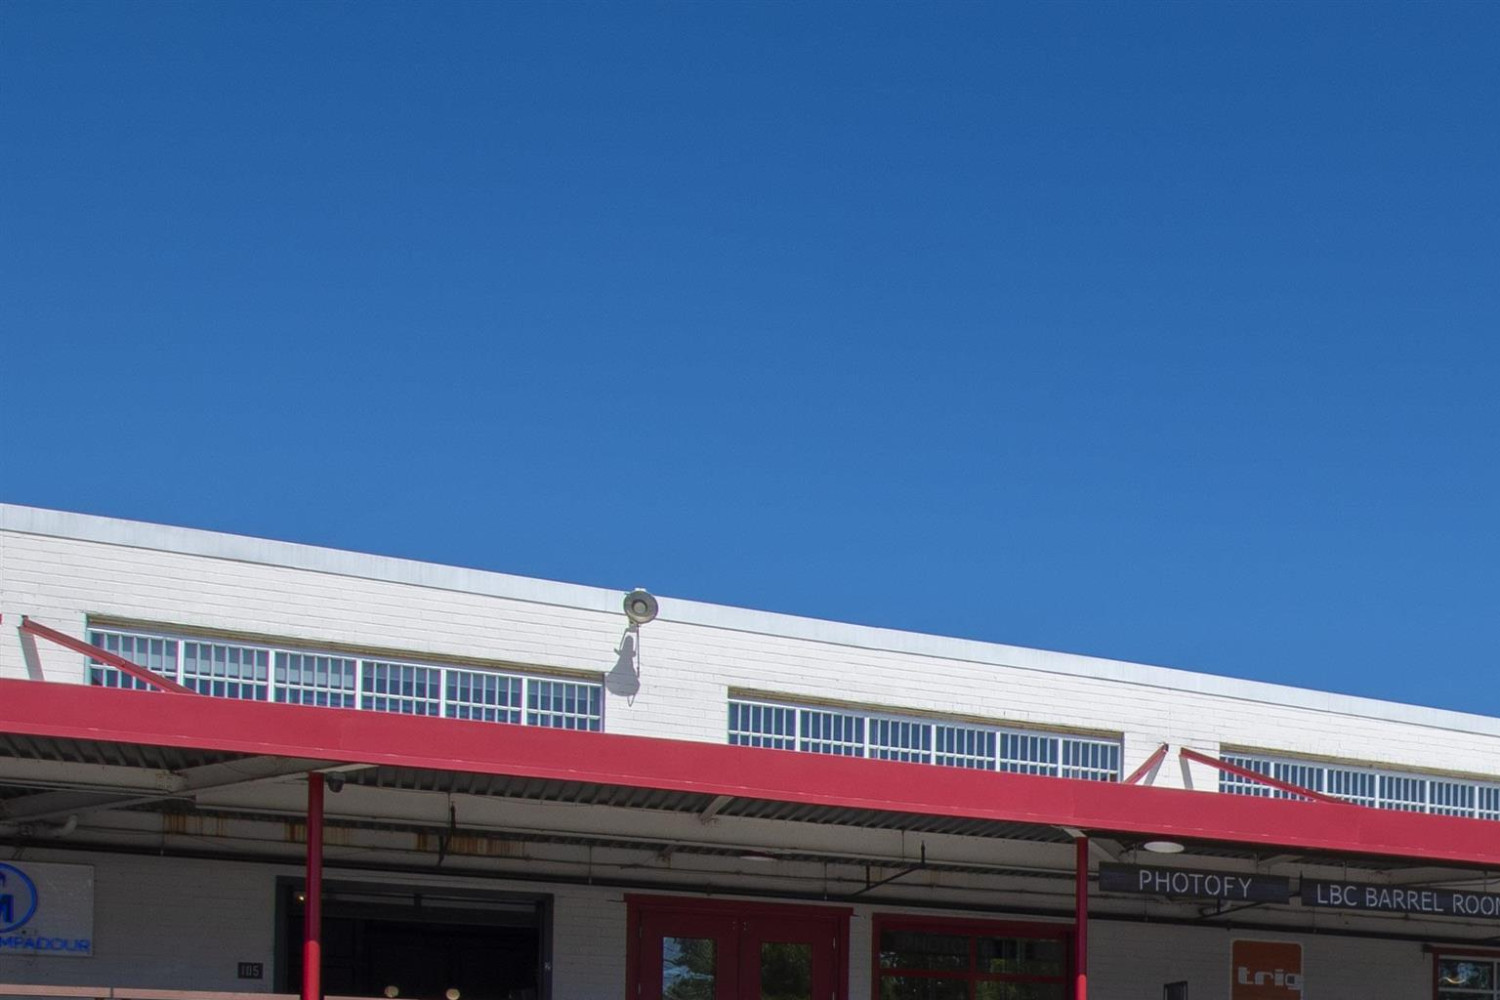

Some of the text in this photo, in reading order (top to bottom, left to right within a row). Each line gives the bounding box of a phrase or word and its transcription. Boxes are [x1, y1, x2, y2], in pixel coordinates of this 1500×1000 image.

[1138, 869, 1252, 898] PHOTOFY
[1316, 883, 1358, 907] LBC
[1365, 887, 1445, 913] BARREL
[1237, 966, 1304, 991] trig
